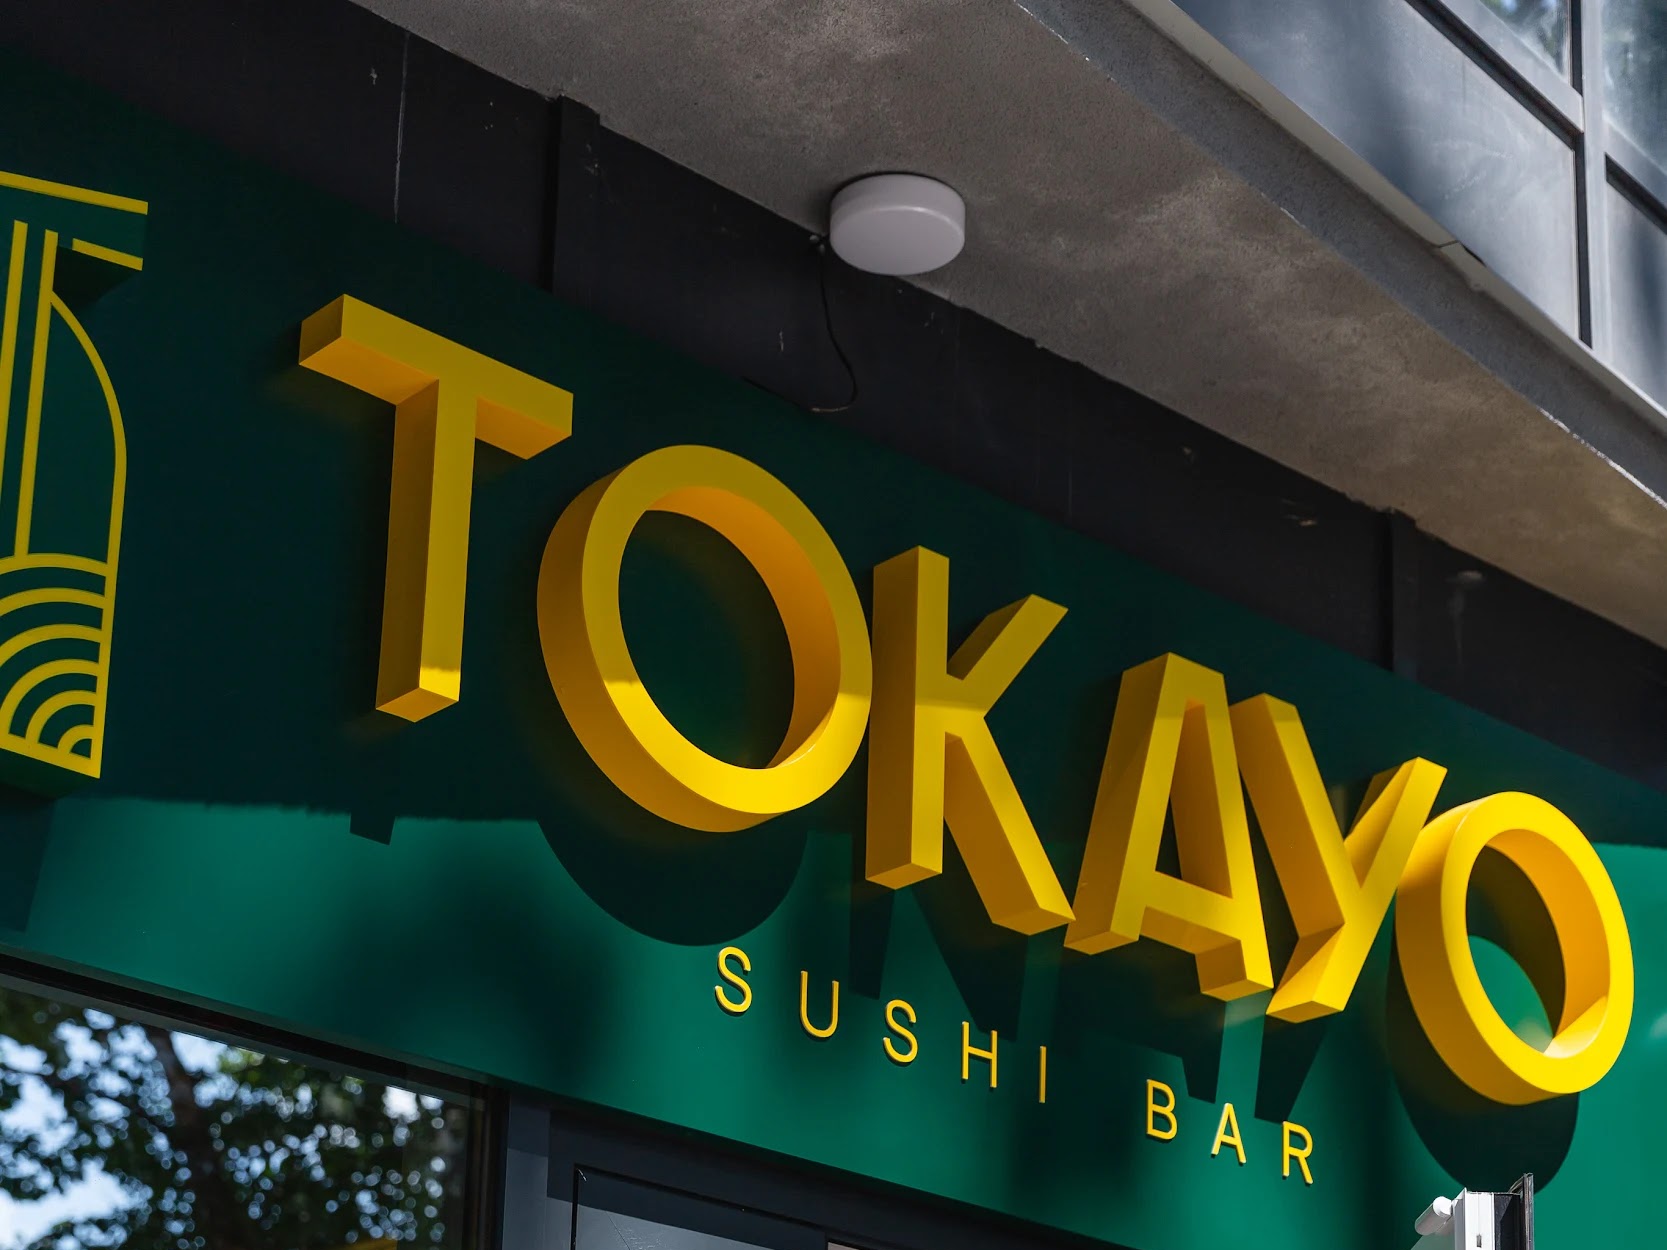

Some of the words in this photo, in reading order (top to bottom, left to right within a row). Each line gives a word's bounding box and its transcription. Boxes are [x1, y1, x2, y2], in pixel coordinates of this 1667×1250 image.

[299, 294, 1635, 1105] TOKAYO
[714, 946, 1047, 1103] SUSHI
[1146, 1079, 1313, 1185] BAR
